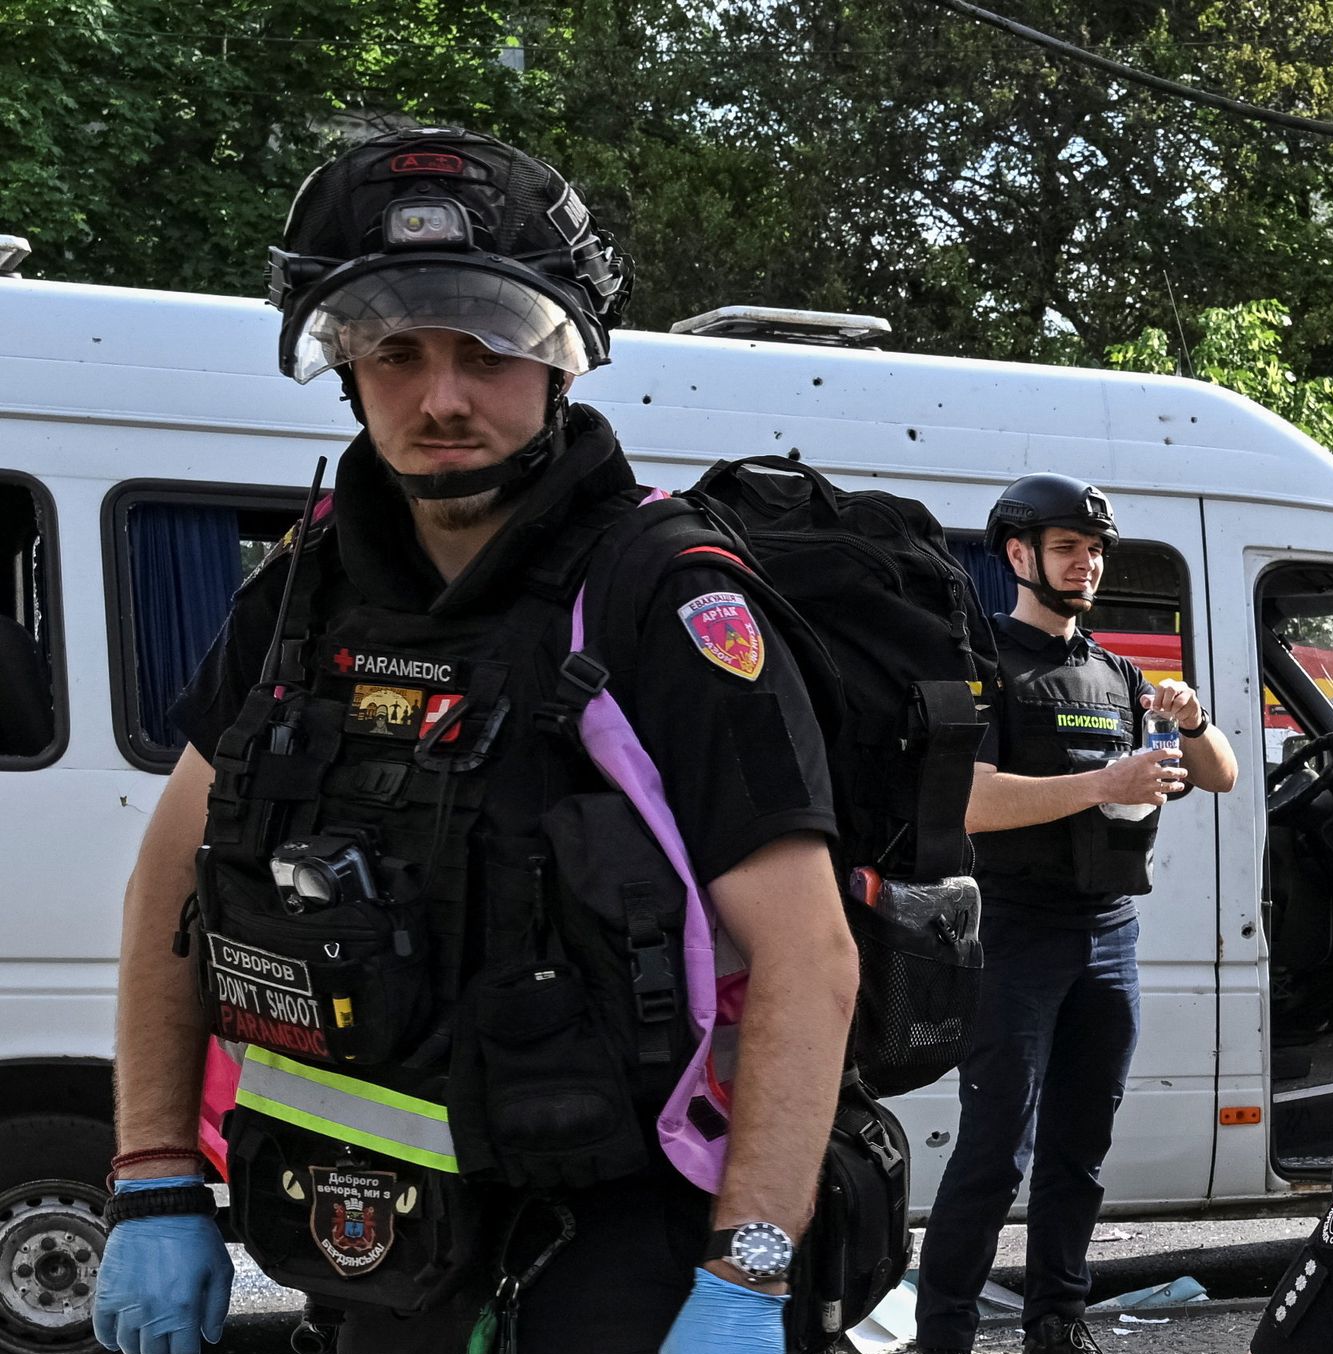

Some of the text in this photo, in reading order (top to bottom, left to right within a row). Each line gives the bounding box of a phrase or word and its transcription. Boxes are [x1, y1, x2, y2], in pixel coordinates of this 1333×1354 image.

[354, 654, 452, 682] PARAMEDIC
[1057, 714, 1119, 731] ПСИХОЛОГ
[222, 945, 295, 981] СУВОРОВ
[216, 972, 320, 1028] DON'T SHOOT
[219, 1004, 331, 1057] PARAMEDIC
[317, 1185, 391, 1199] вечора, ми з
[328, 1172, 380, 1187] Доброго
